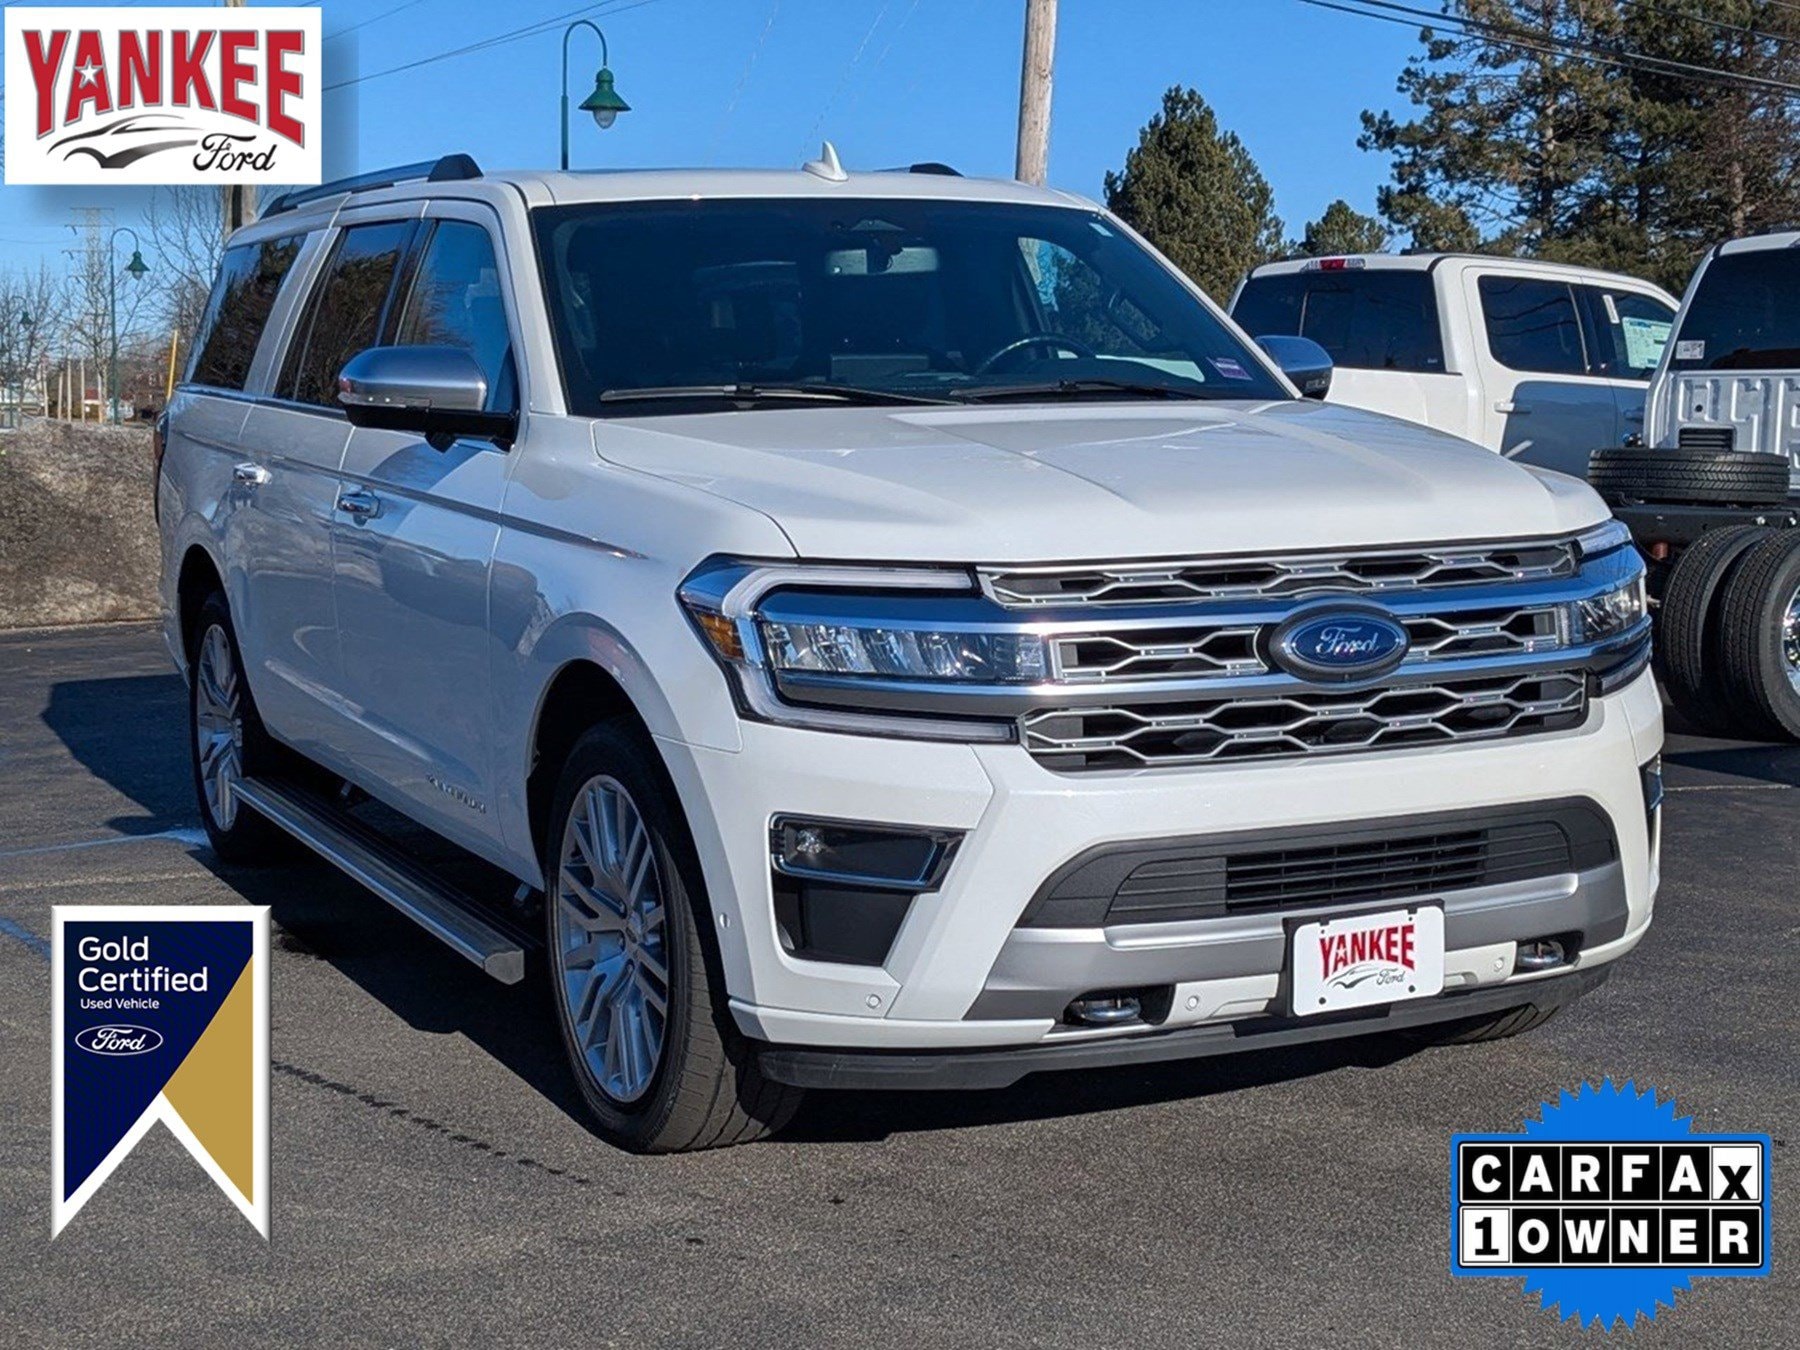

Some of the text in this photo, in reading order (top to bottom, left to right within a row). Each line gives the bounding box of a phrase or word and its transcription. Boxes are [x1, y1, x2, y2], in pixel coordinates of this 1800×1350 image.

[1315, 626, 1379, 654] Ford
[1319, 924, 1415, 981] YANKEE
[1376, 967, 1406, 986] Ford
